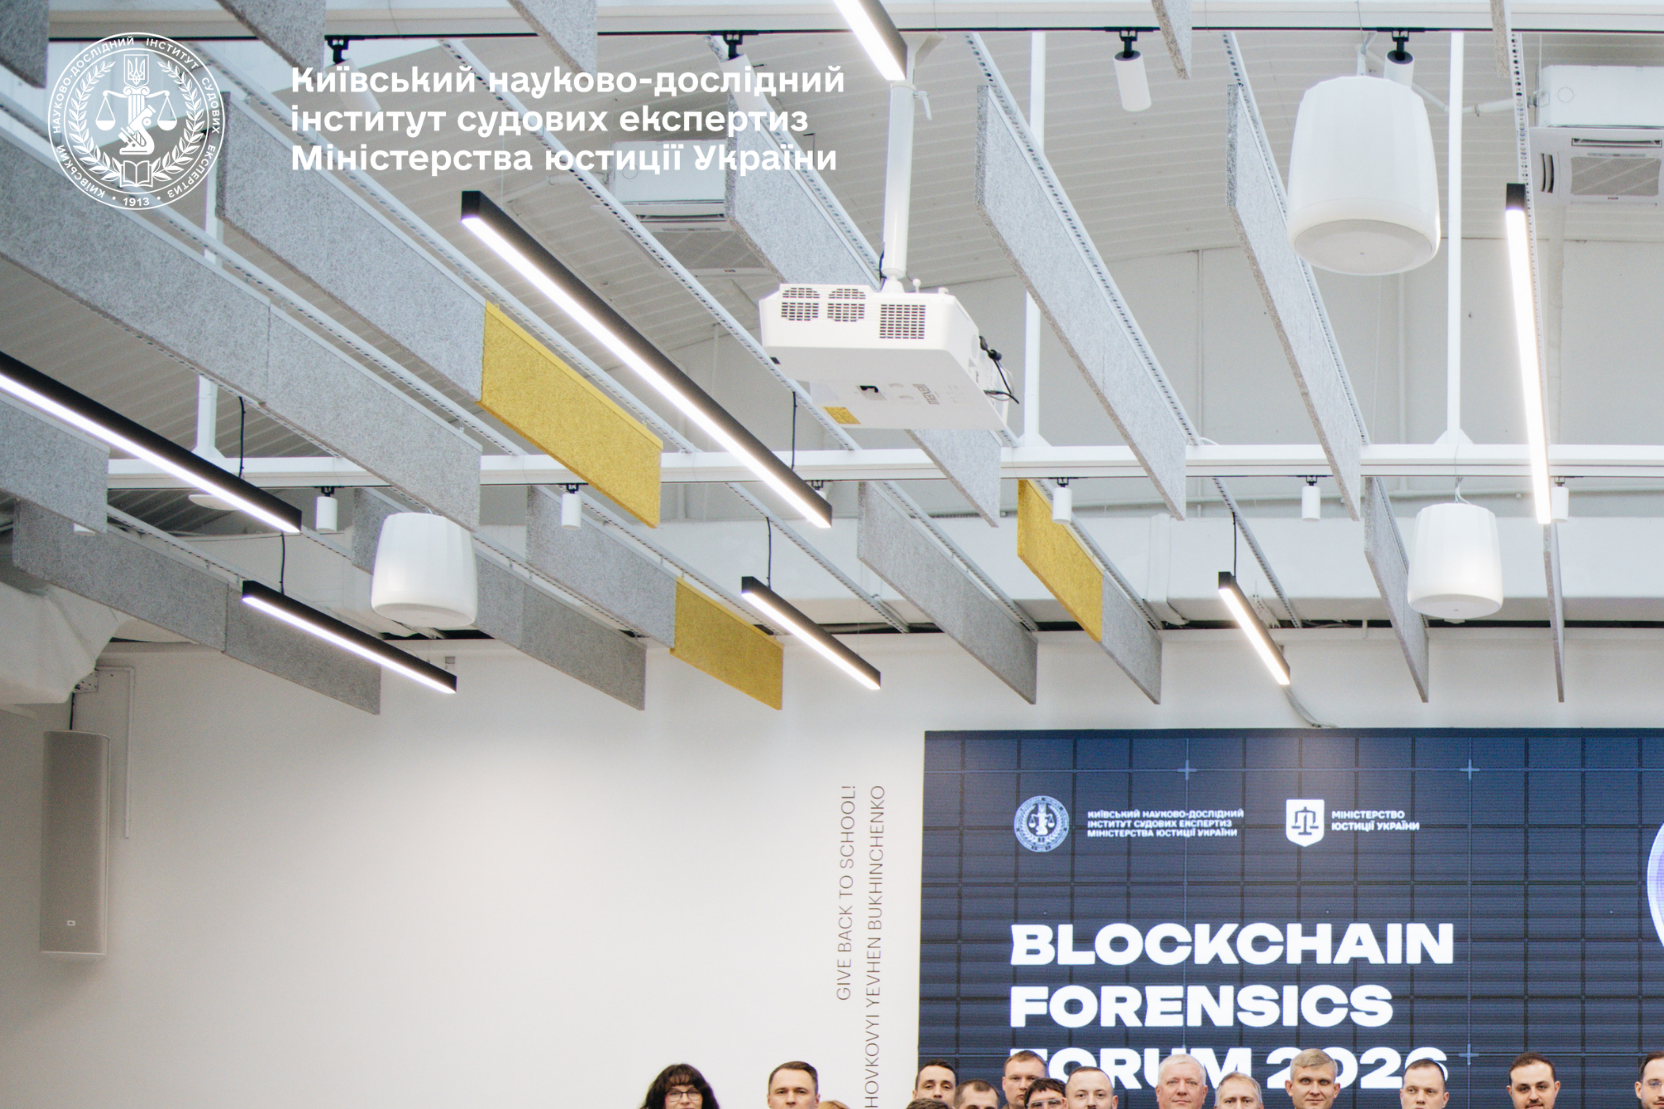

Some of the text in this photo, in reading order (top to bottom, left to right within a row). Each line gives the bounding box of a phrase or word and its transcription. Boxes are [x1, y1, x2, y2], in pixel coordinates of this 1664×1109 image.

[1088, 809, 1244, 818] КИЇВСЬКИЙ НАУКОВО-ДОСЛІДНИЙ
[1088, 819, 1232, 829] ІНСТИТУТ СУДОВИХ ЕКСПЕРТИЗ
[1088, 828, 1238, 838] МІНІСТЕРСТВА ЮСТИЦІЇ УКРАЇНИ
[1332, 811, 1405, 819] МІНІСТЕРСТВО
[1332, 820, 1420, 832] ЮСТИЦІЇ УКРАЇНИ
[868, 786, 884, 929] BUKHINCHENKO
[837, 786, 855, 1000] GIVE BACK TO SCHOOL!
[1010, 923, 1454, 966] BLOCKCHAIN
[866, 938, 881, 1007] YEVHEN
[1010, 985, 1394, 1028] FORENSICS
[1010, 1047, 1252, 1089] ORUM
